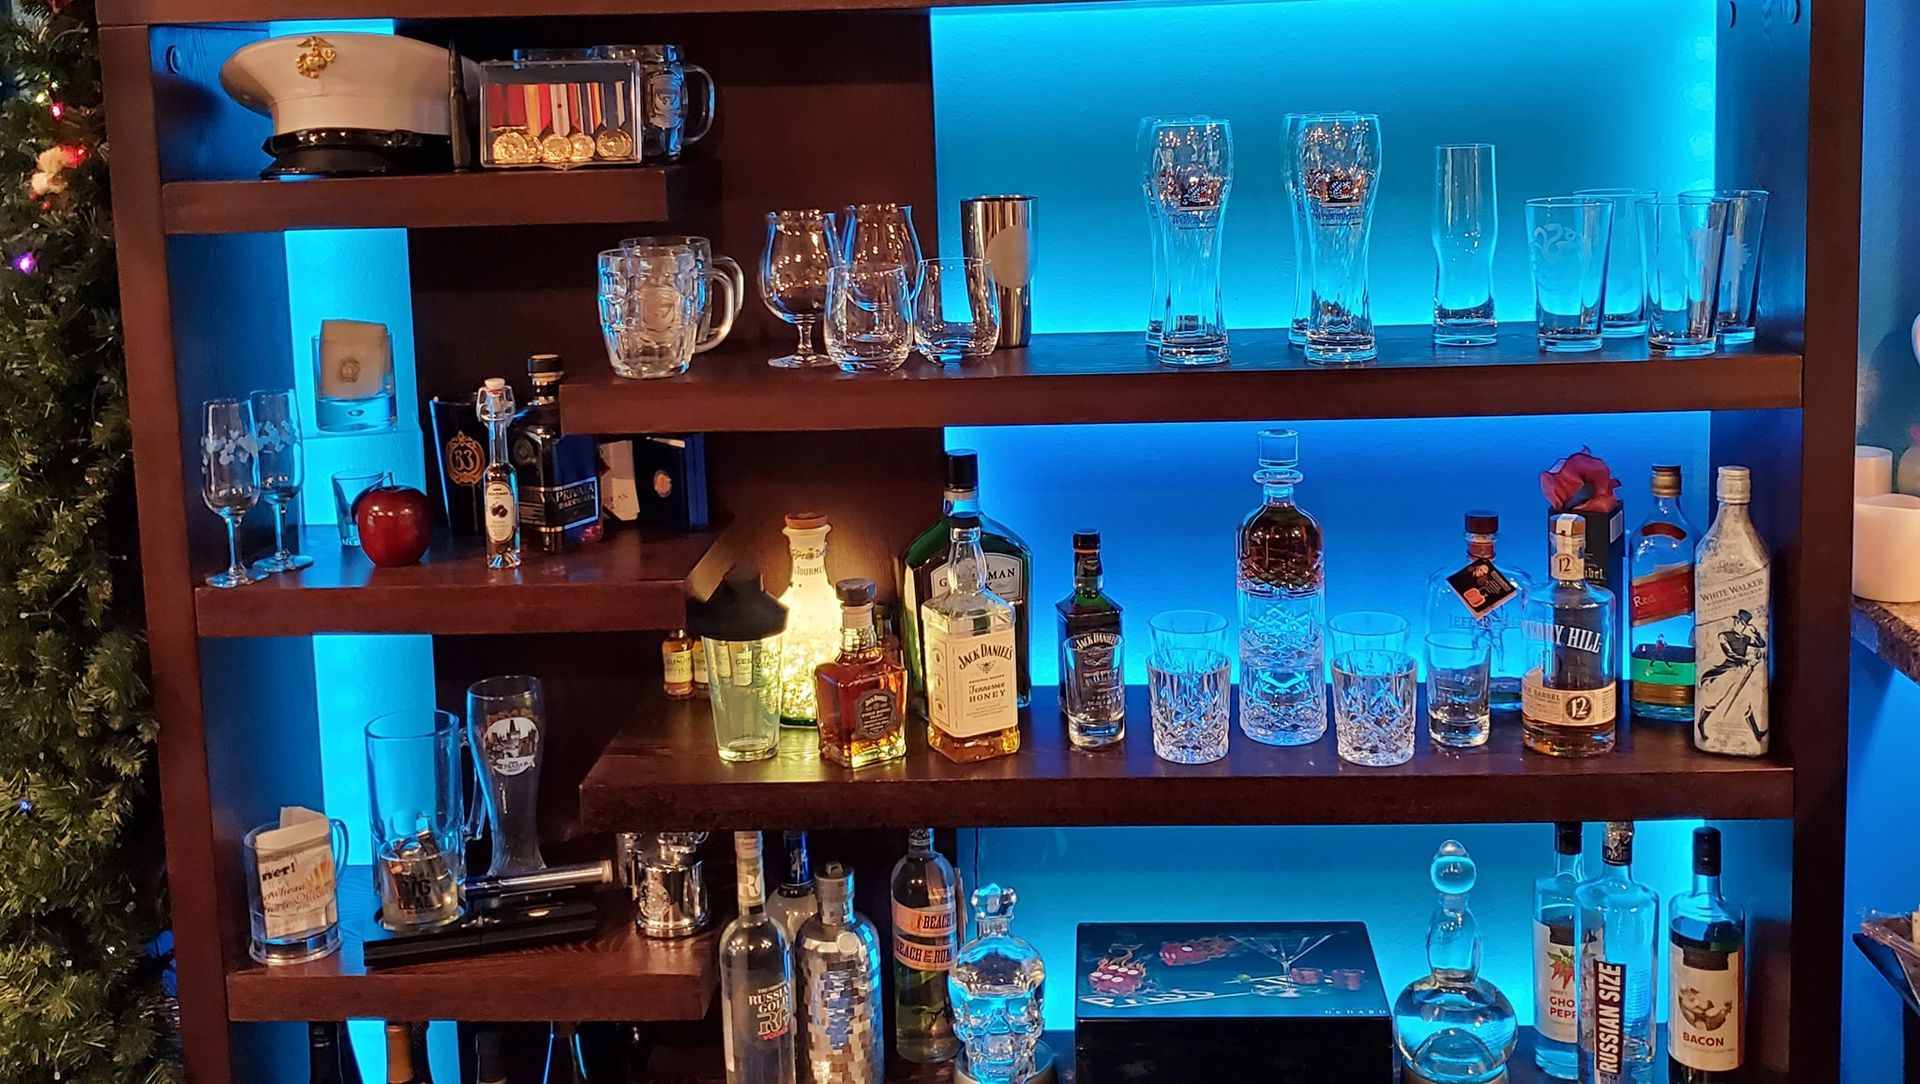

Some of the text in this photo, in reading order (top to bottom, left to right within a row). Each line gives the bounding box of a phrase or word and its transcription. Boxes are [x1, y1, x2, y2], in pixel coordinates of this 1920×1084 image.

[1558, 557, 1571, 572] 12
[1700, 589, 1728, 602] WHITE
[1728, 578, 1764, 594] WALKER
[1076, 635, 1094, 653] JACK
[1567, 626, 1602, 654] HILL
[958, 643, 1013, 670] JACK DANIEL'S
[969, 689, 1006, 703] HONEY
[1571, 697, 1588, 718] 12
[1599, 962, 1622, 1003] SIZE
[1550, 996, 1575, 1009] GHO
[1599, 1003, 1621, 1074] RUSSIAN
[1682, 1031, 1724, 1047] BACON
